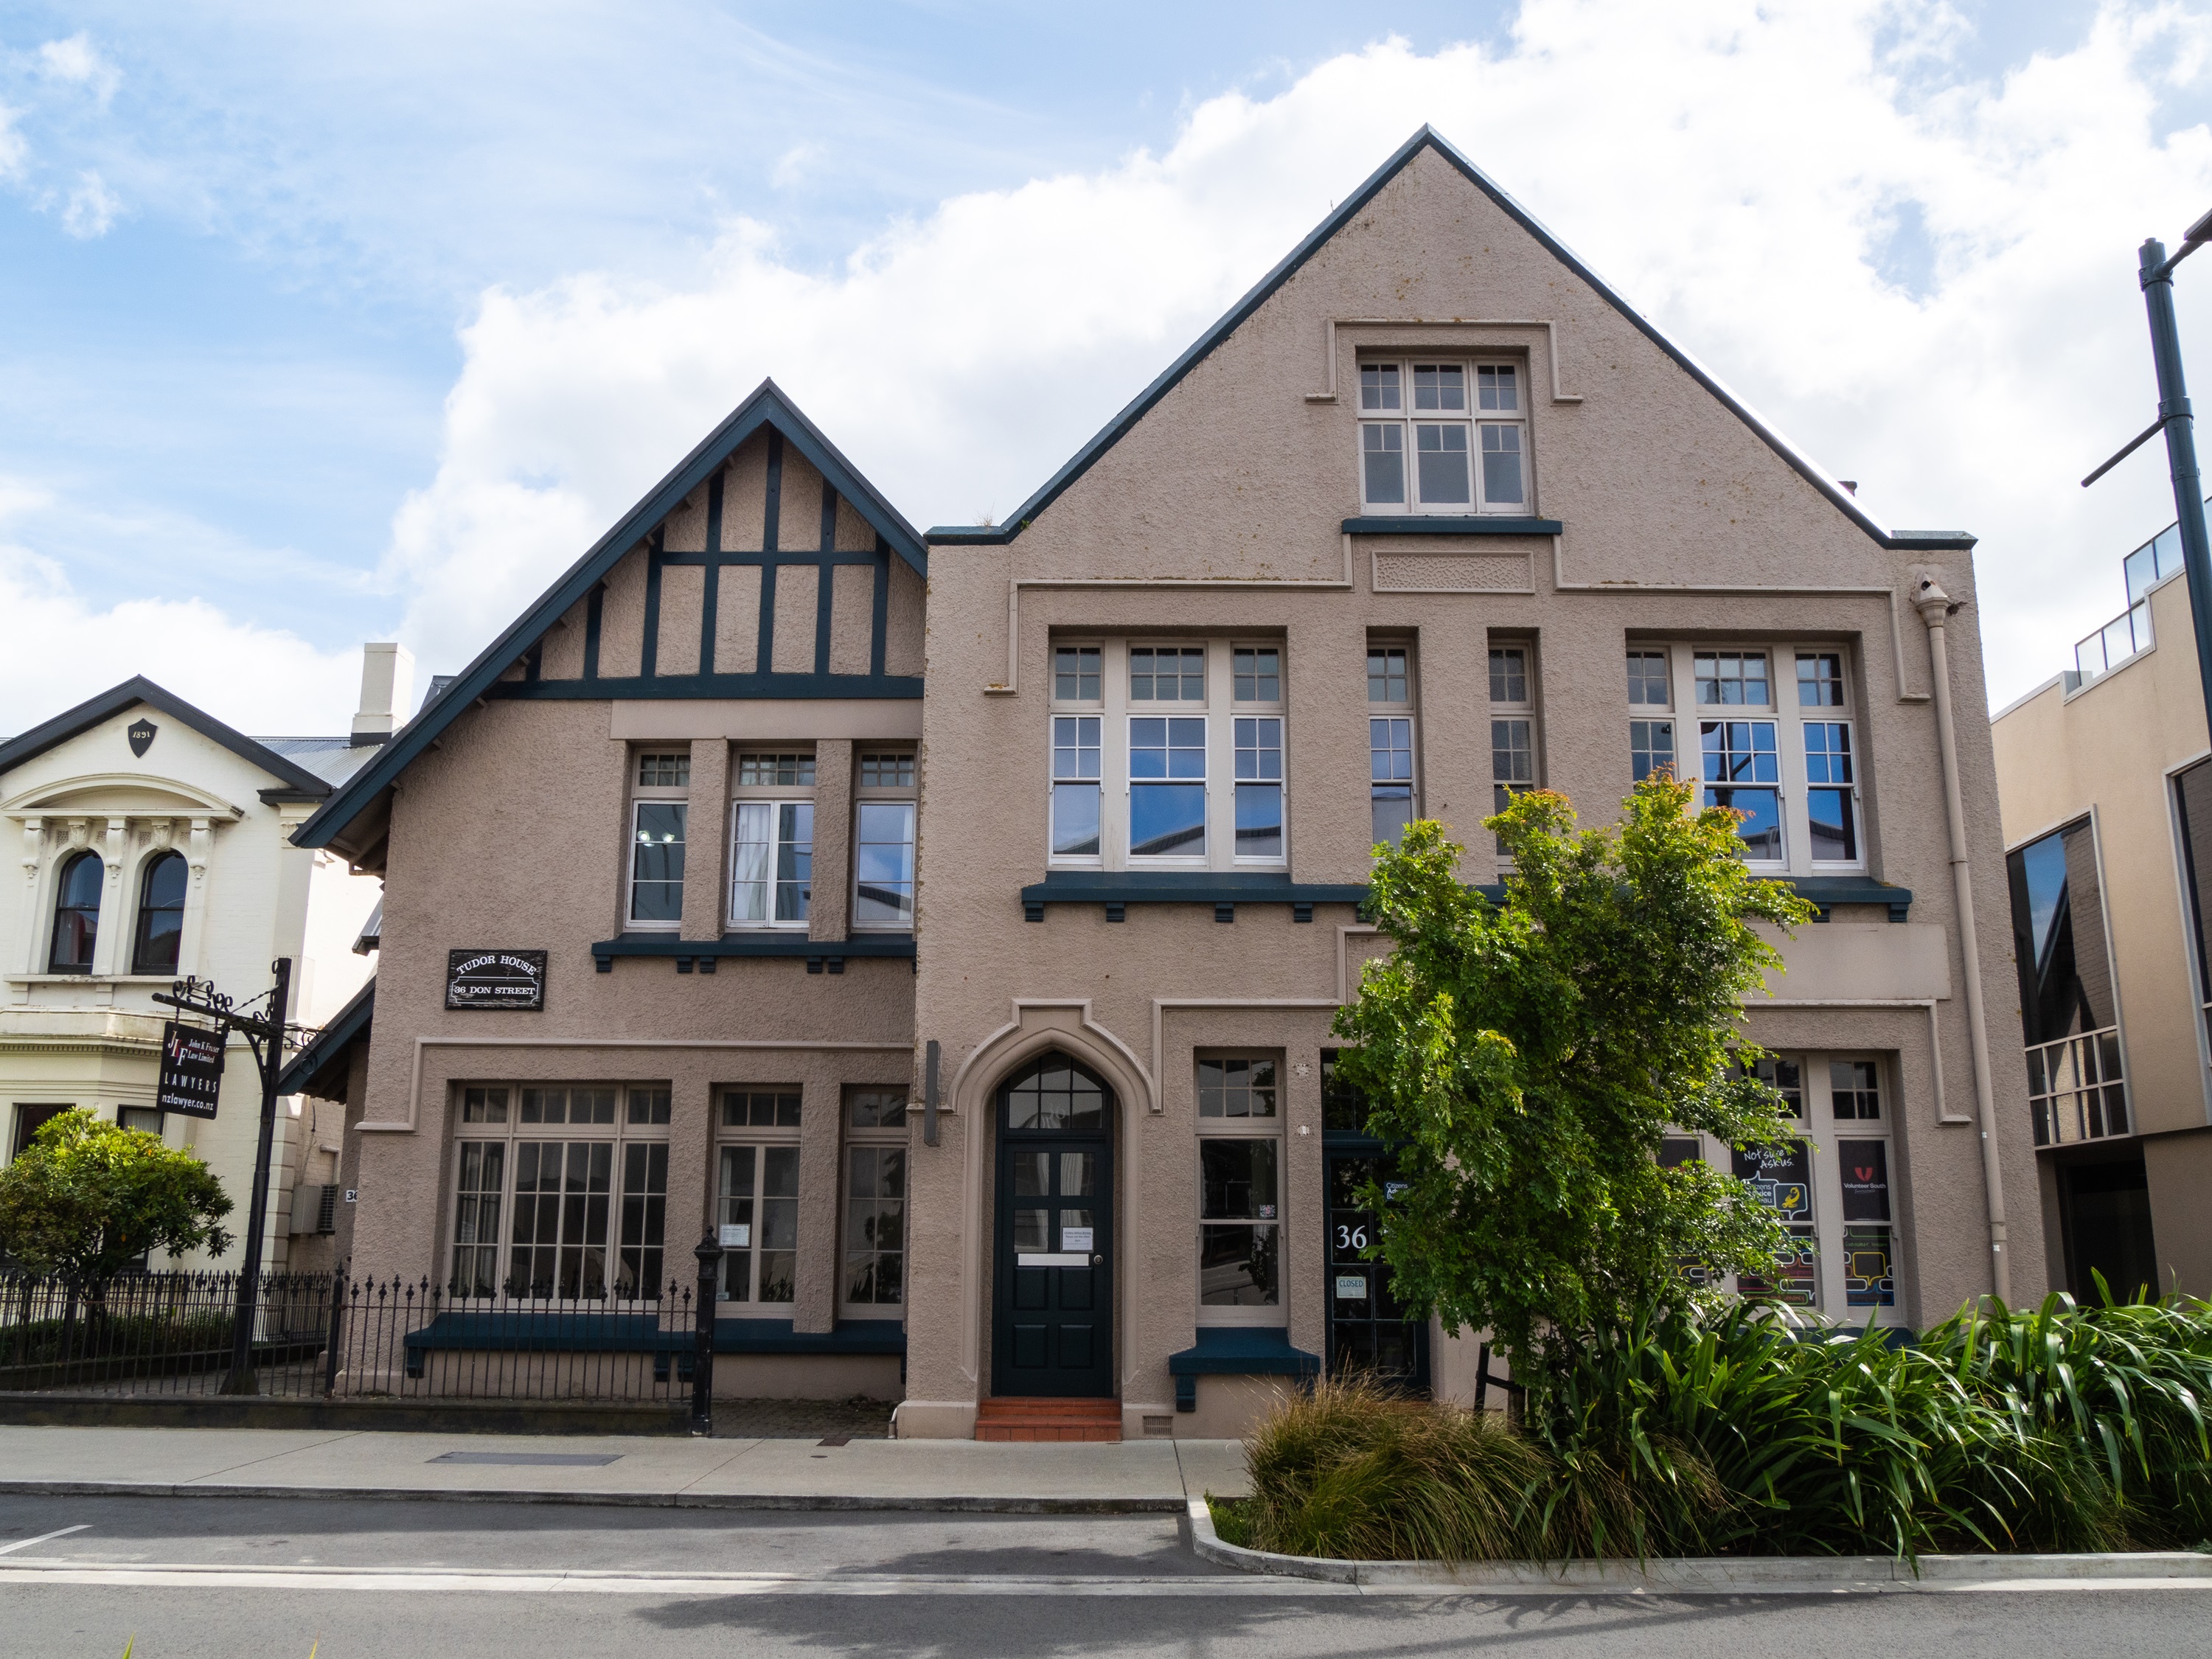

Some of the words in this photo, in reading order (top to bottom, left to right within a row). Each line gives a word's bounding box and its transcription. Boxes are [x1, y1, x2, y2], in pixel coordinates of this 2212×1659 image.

[133, 731, 150, 739] 1891
[456, 955, 495, 975] TUDOR
[500, 955, 537, 975] HOUSE
[454, 986, 466, 994] 36
[470, 986, 492, 994] DON
[495, 987, 535, 995] STREET
[188, 1038, 201, 1049] John
[201, 1041, 206, 1050] K
[187, 1050, 198, 1060] Law
[198, 1052, 215, 1063] Limited
[164, 1072, 217, 1093] LAWYERS
[162, 1093, 214, 1110] nzlawyer.co.nz
[1744, 1149, 1761, 1161] Not
[1336, 1225, 1367, 1249] 36
[1339, 1279, 1363, 1287] CLOSED
